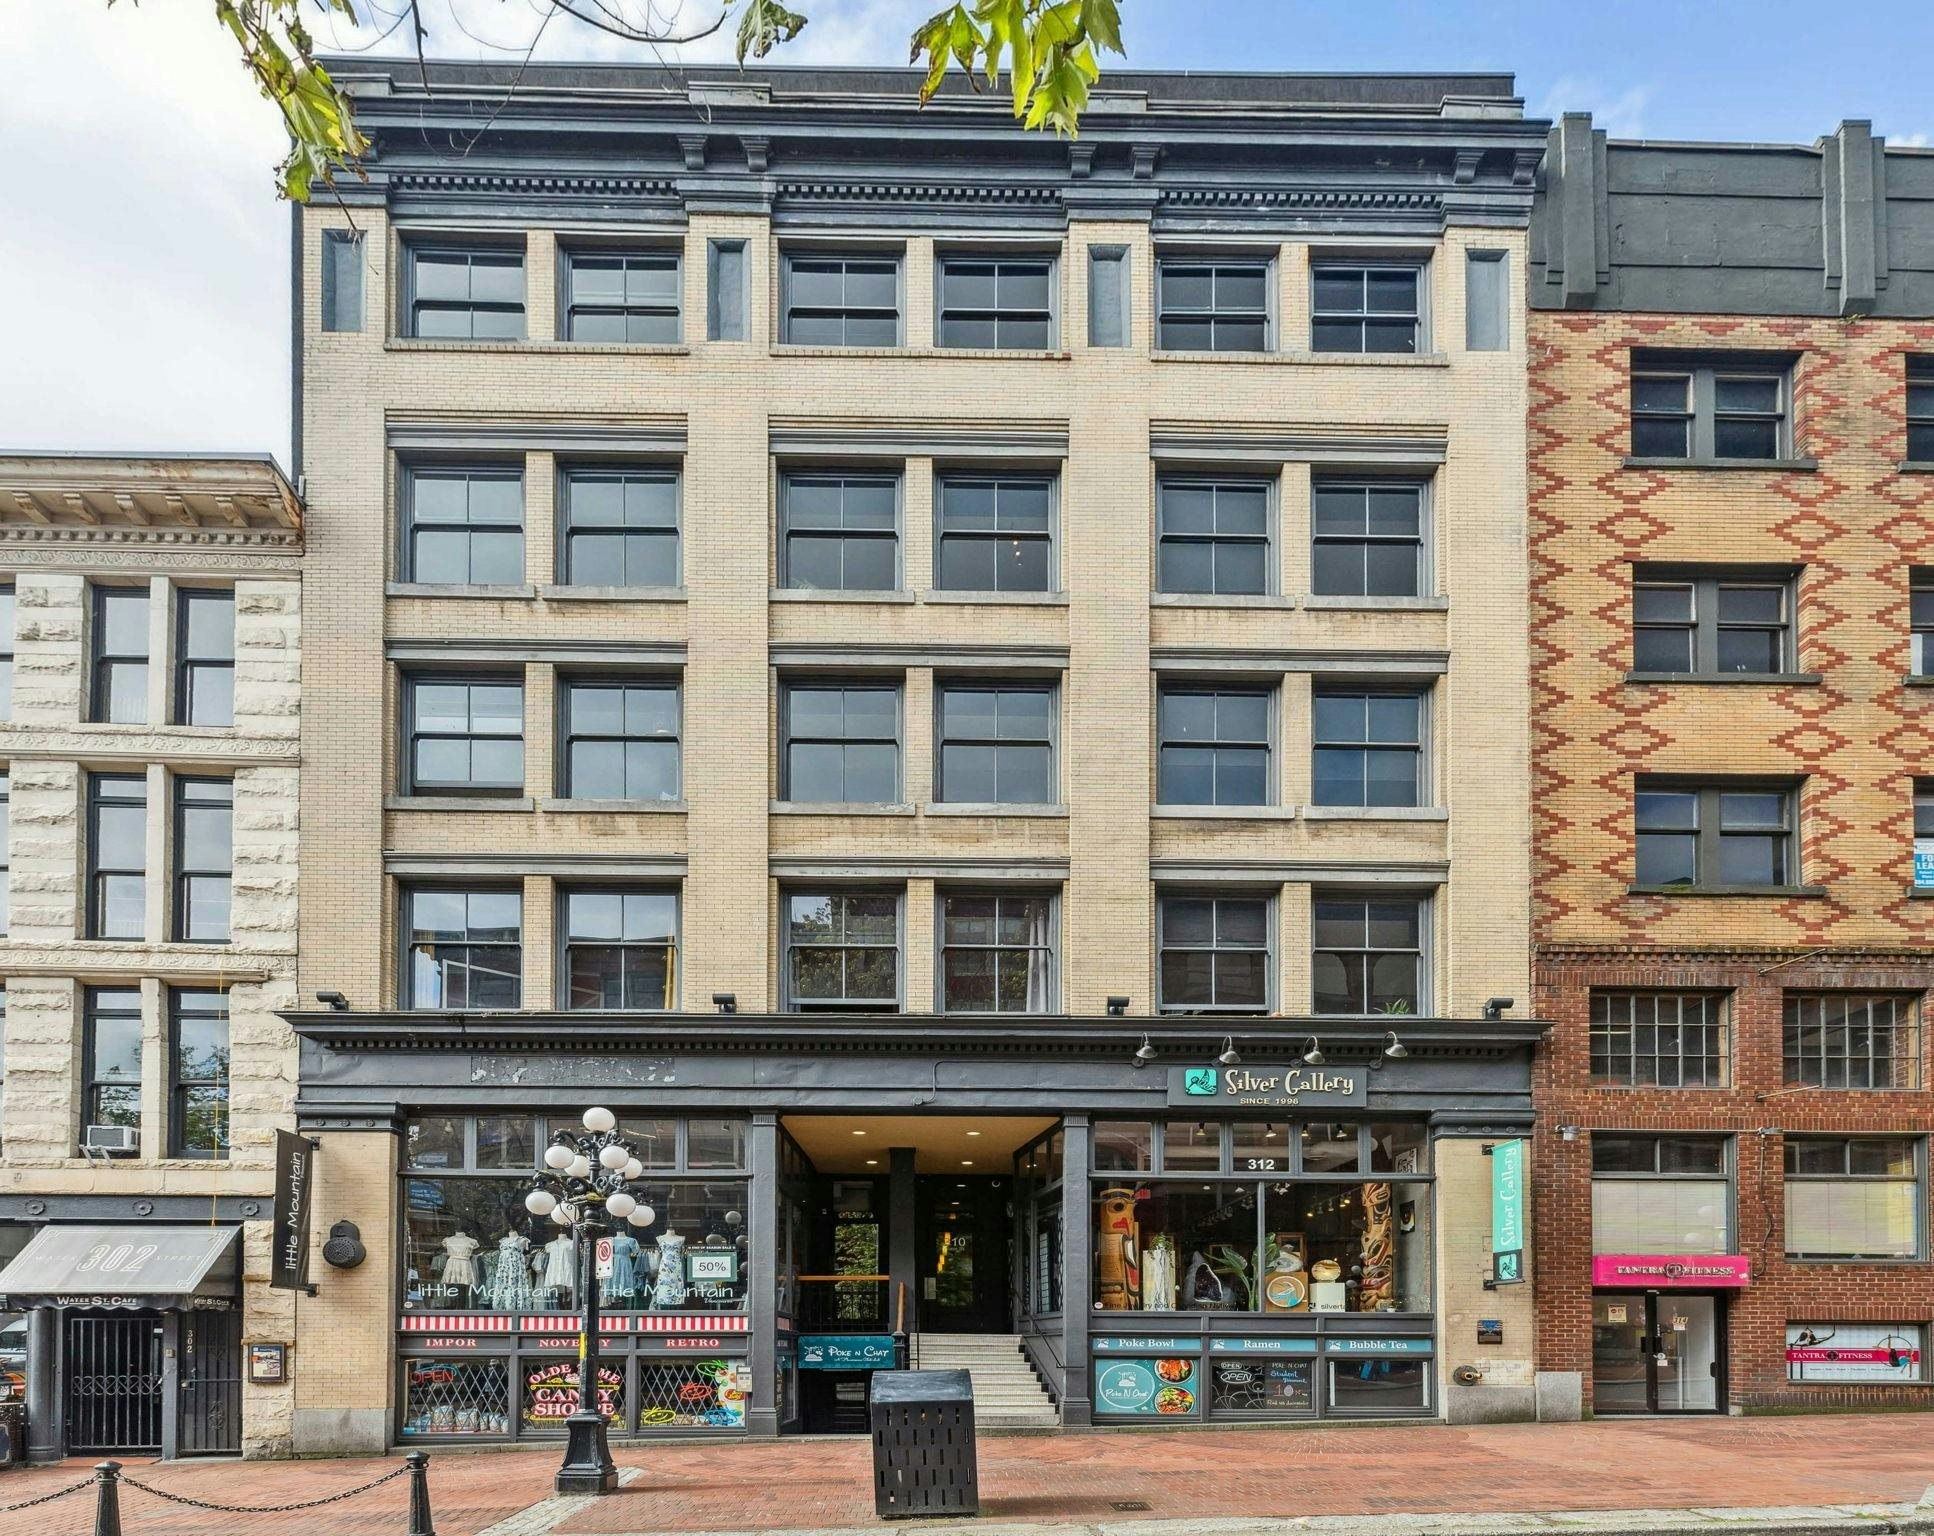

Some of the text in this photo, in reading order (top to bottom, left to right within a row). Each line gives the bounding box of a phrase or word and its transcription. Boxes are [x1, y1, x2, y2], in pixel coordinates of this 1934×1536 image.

[1224, 1069, 1354, 1096] Silver Gallery
[1240, 1097, 1270, 1105] SINCE
[1247, 1158, 1275, 1170] 312
[1500, 1147, 1517, 1246] Silver Gallery
[285, 1152, 302, 1270] little Mountain
[76, 1244, 158, 1272] 302
[699, 1261, 727, 1272] 50%
[1684, 1265, 1735, 1275] FITNESS
[418, 1283, 558, 1298] little Mountain
[599, 1283, 733, 1299] ttle Mountain
[186, 1329, 194, 1354] 302
[425, 1338, 477, 1348] IMPOR
[539, 1339, 611, 1348] NOVEY
[665, 1338, 720, 1348] RETRO
[1118, 1338, 1175, 1348] Poke Bowl
[1244, 1340, 1281, 1349] Ramen
[1349, 1340, 1408, 1349] Bubble Tea
[411, 1369, 454, 1384] OPEN
[529, 1364, 572, 1385] OLDE
[1221, 1372, 1251, 1382] OPEN
[535, 1388, 613, 1402] CANY
[533, 1402, 615, 1416] SHOE
